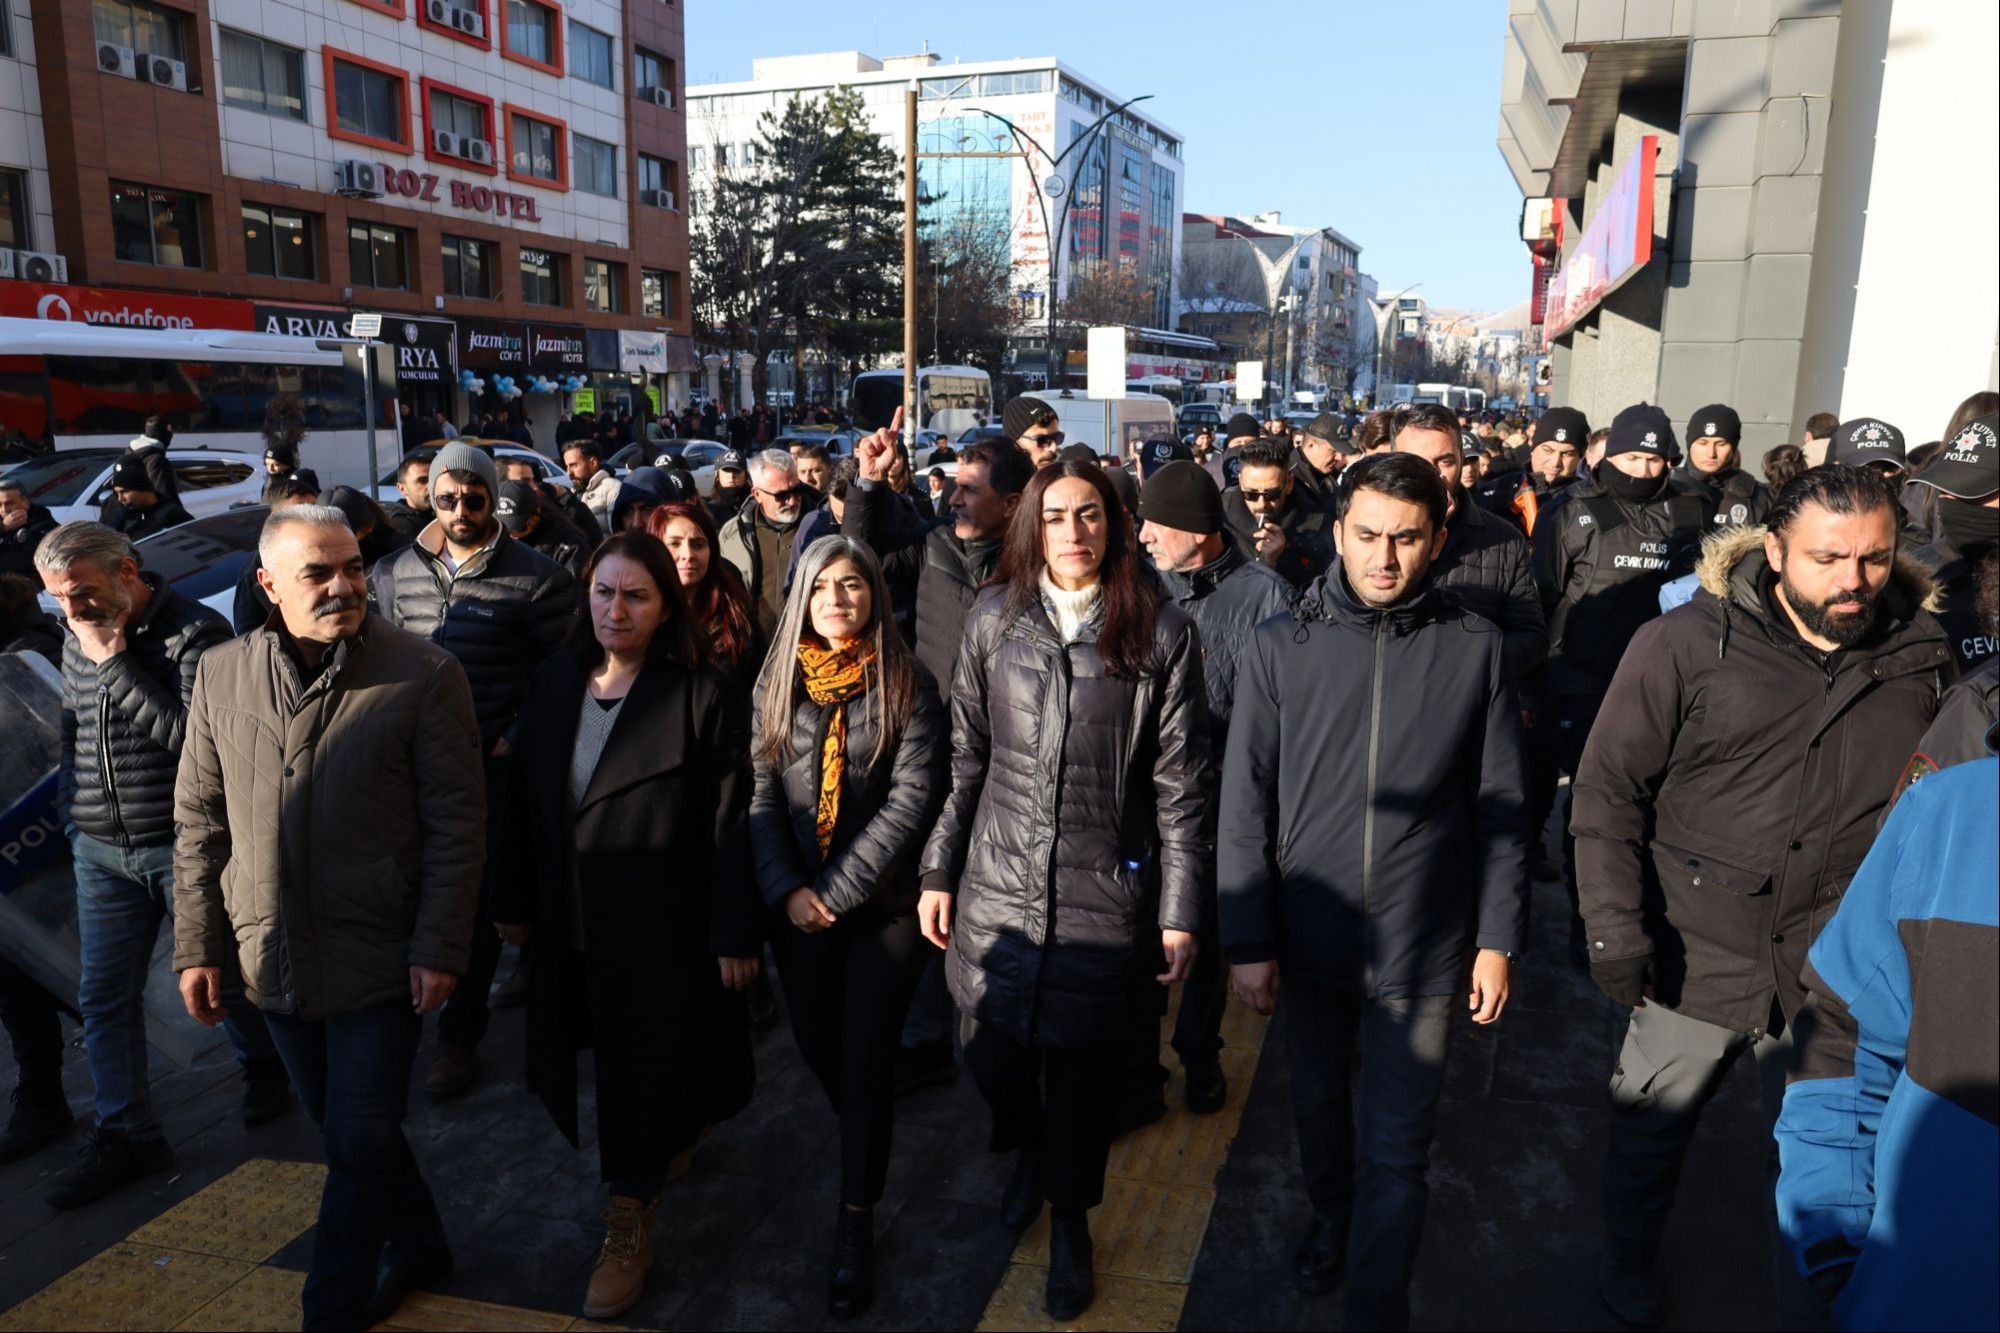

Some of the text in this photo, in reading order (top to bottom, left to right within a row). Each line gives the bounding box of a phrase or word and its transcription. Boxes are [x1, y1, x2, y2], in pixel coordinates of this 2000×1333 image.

[449, 179, 542, 223] HOTEL
[83, 306, 194, 330] vodafone
[468, 330, 522, 352] jazminn
[534, 333, 583, 356] jazminn
[400, 346, 440, 369] RYA
[562, 353, 584, 363] HOTEL
